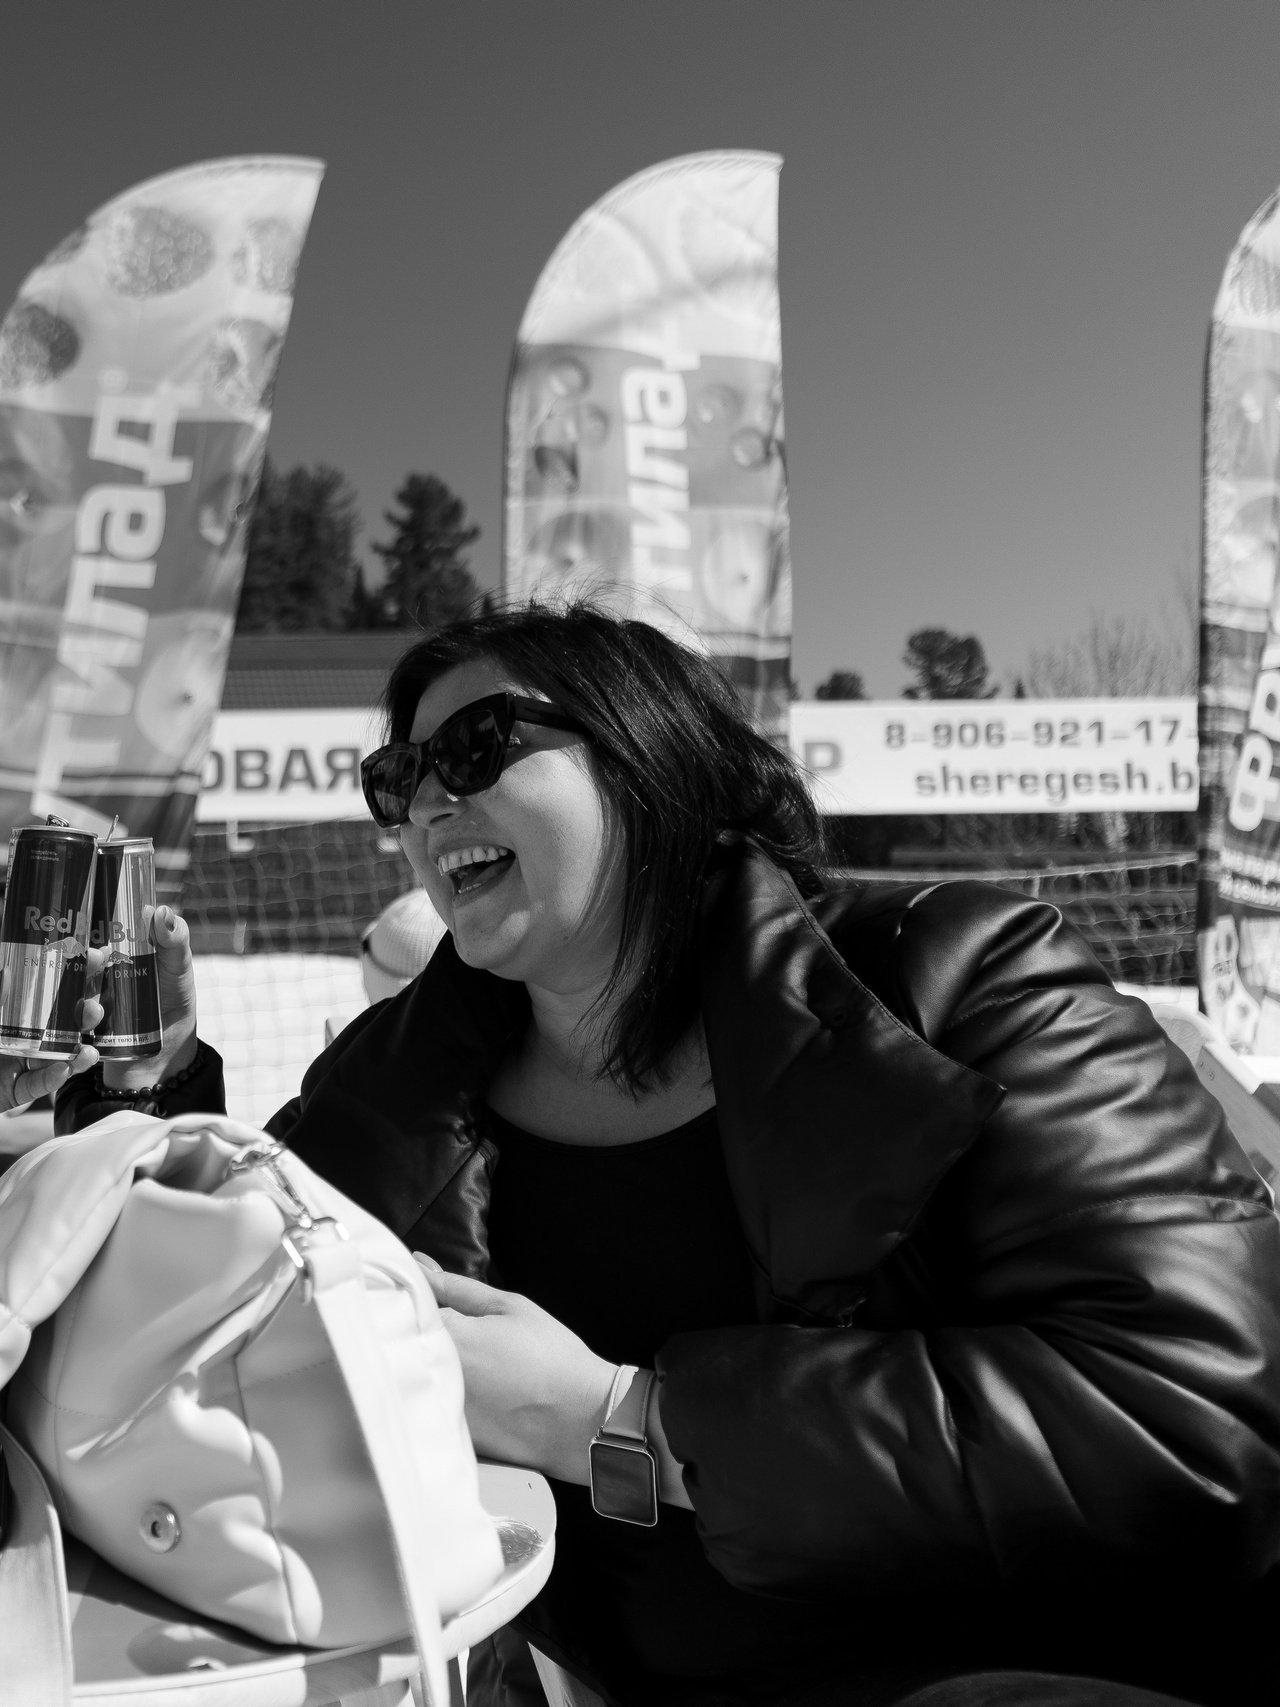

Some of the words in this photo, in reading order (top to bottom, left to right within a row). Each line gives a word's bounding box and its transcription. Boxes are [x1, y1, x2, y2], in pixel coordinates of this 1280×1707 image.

[24, 906, 73, 934] Red
[23, 957, 72, 972] ENERGY
[115, 967, 149, 980] DRINK
